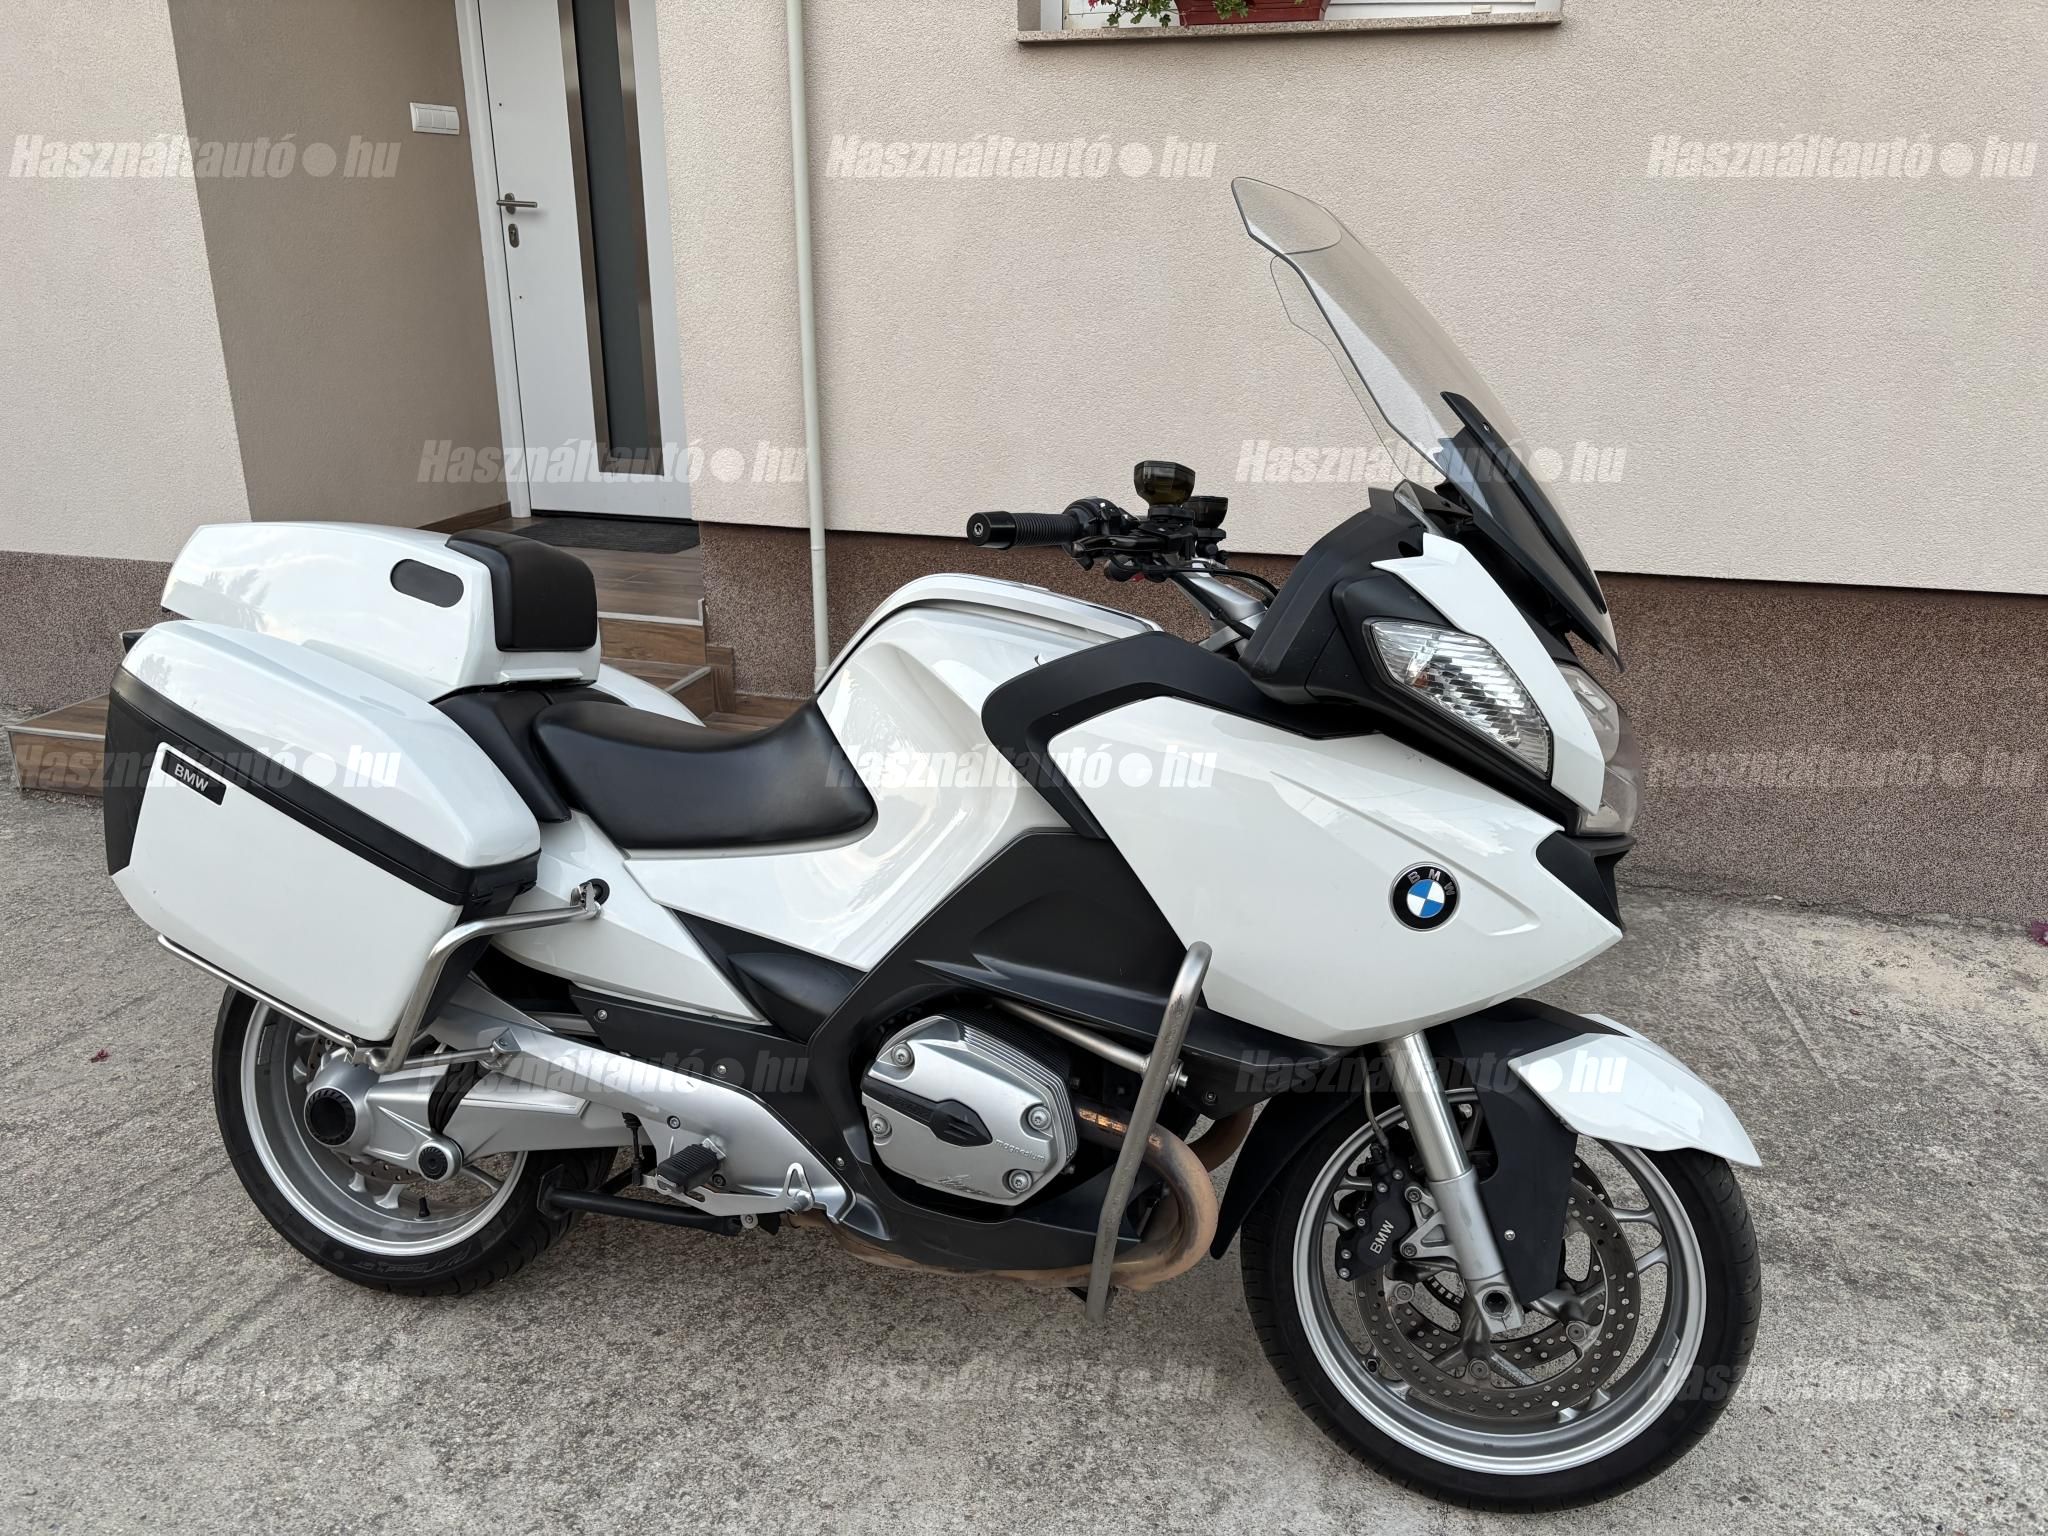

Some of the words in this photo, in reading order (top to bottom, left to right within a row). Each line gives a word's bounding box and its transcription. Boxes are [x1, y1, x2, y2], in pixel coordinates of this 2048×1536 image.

[174, 763, 209, 792] BMW
[1407, 868, 1456, 896] BMW
[1370, 1220, 1394, 1254] BMW
